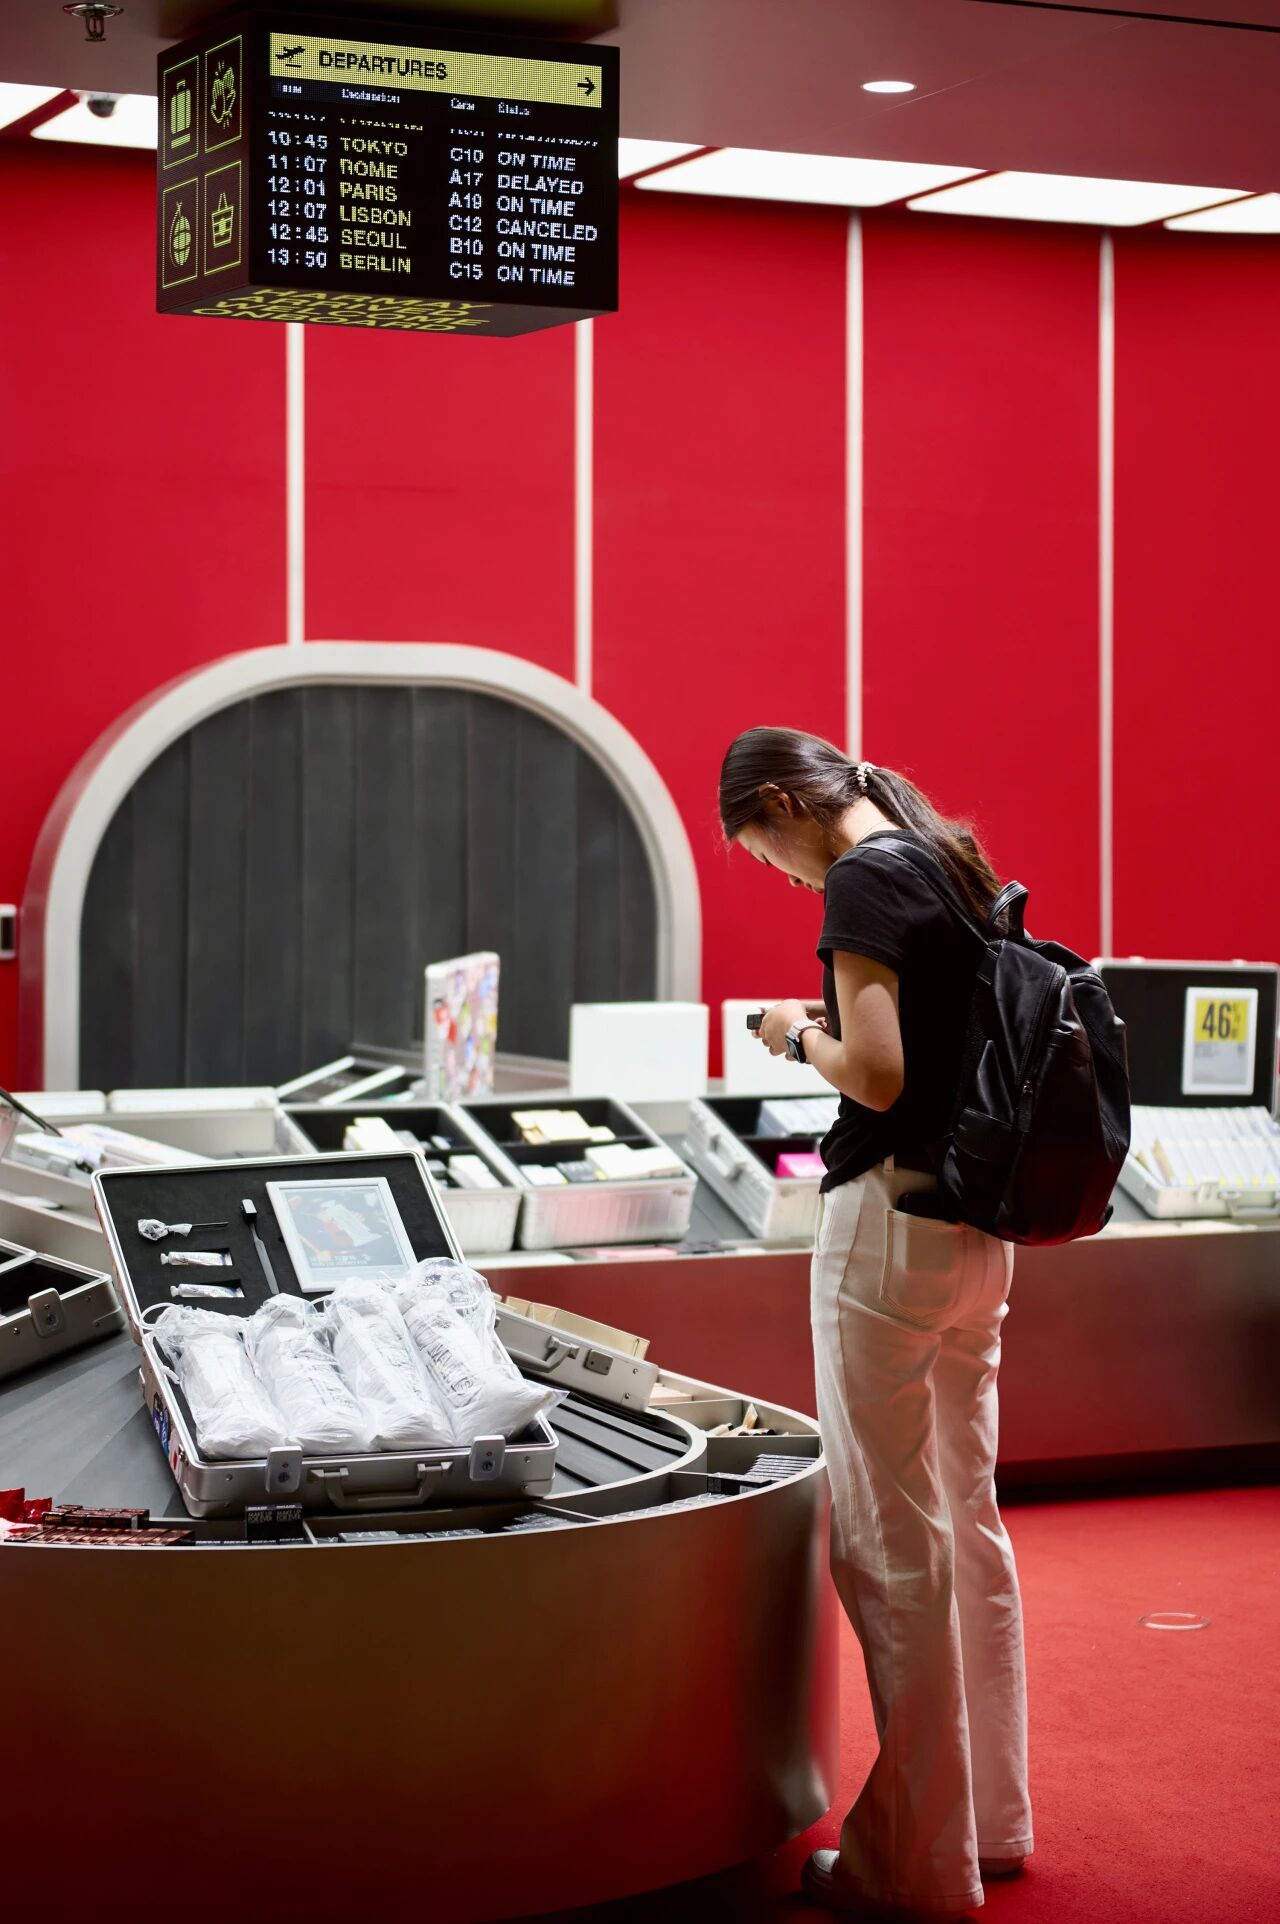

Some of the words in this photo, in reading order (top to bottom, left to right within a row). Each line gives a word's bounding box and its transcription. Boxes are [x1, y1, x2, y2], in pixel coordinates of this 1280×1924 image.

[319, 50, 447, 80] DEPARTURES
[268, 130, 328, 150] 10:45
[340, 137, 408, 156] TOKYO
[450, 147, 484, 164] C10
[498, 151, 525, 167] ON
[530, 154, 576, 172] TIME
[268, 154, 327, 173] 11:07
[340, 158, 398, 179] ROME
[449, 168, 484, 187] A17
[497, 174, 584, 195] DELAYED
[268, 175, 326, 196] 12:01
[340, 181, 398, 202] PARIS
[497, 195, 524, 213] ON
[529, 197, 576, 217] TIME
[268, 199, 327, 220] 12:07
[340, 204, 411, 227] LISBON
[449, 214, 482, 233] C12
[496, 218, 598, 241] CANCELED
[269, 222, 329, 243] 12:45
[341, 228, 407, 250] SEOUL
[449, 237, 484, 256] B10
[497, 240, 525, 259] ON
[530, 243, 576, 263] TIME
[268, 248, 327, 269] 13:50
[340, 252, 411, 274] BERLIN
[449, 260, 484, 281] C15
[497, 264, 524, 283] ON
[529, 267, 576, 286] TIME
[215, 301, 490, 326] WELCOME
[228, 295, 470, 317] ARRIVED
[252, 288, 493, 310] HARMAY
[192, 308, 457, 331] ONBOARD
